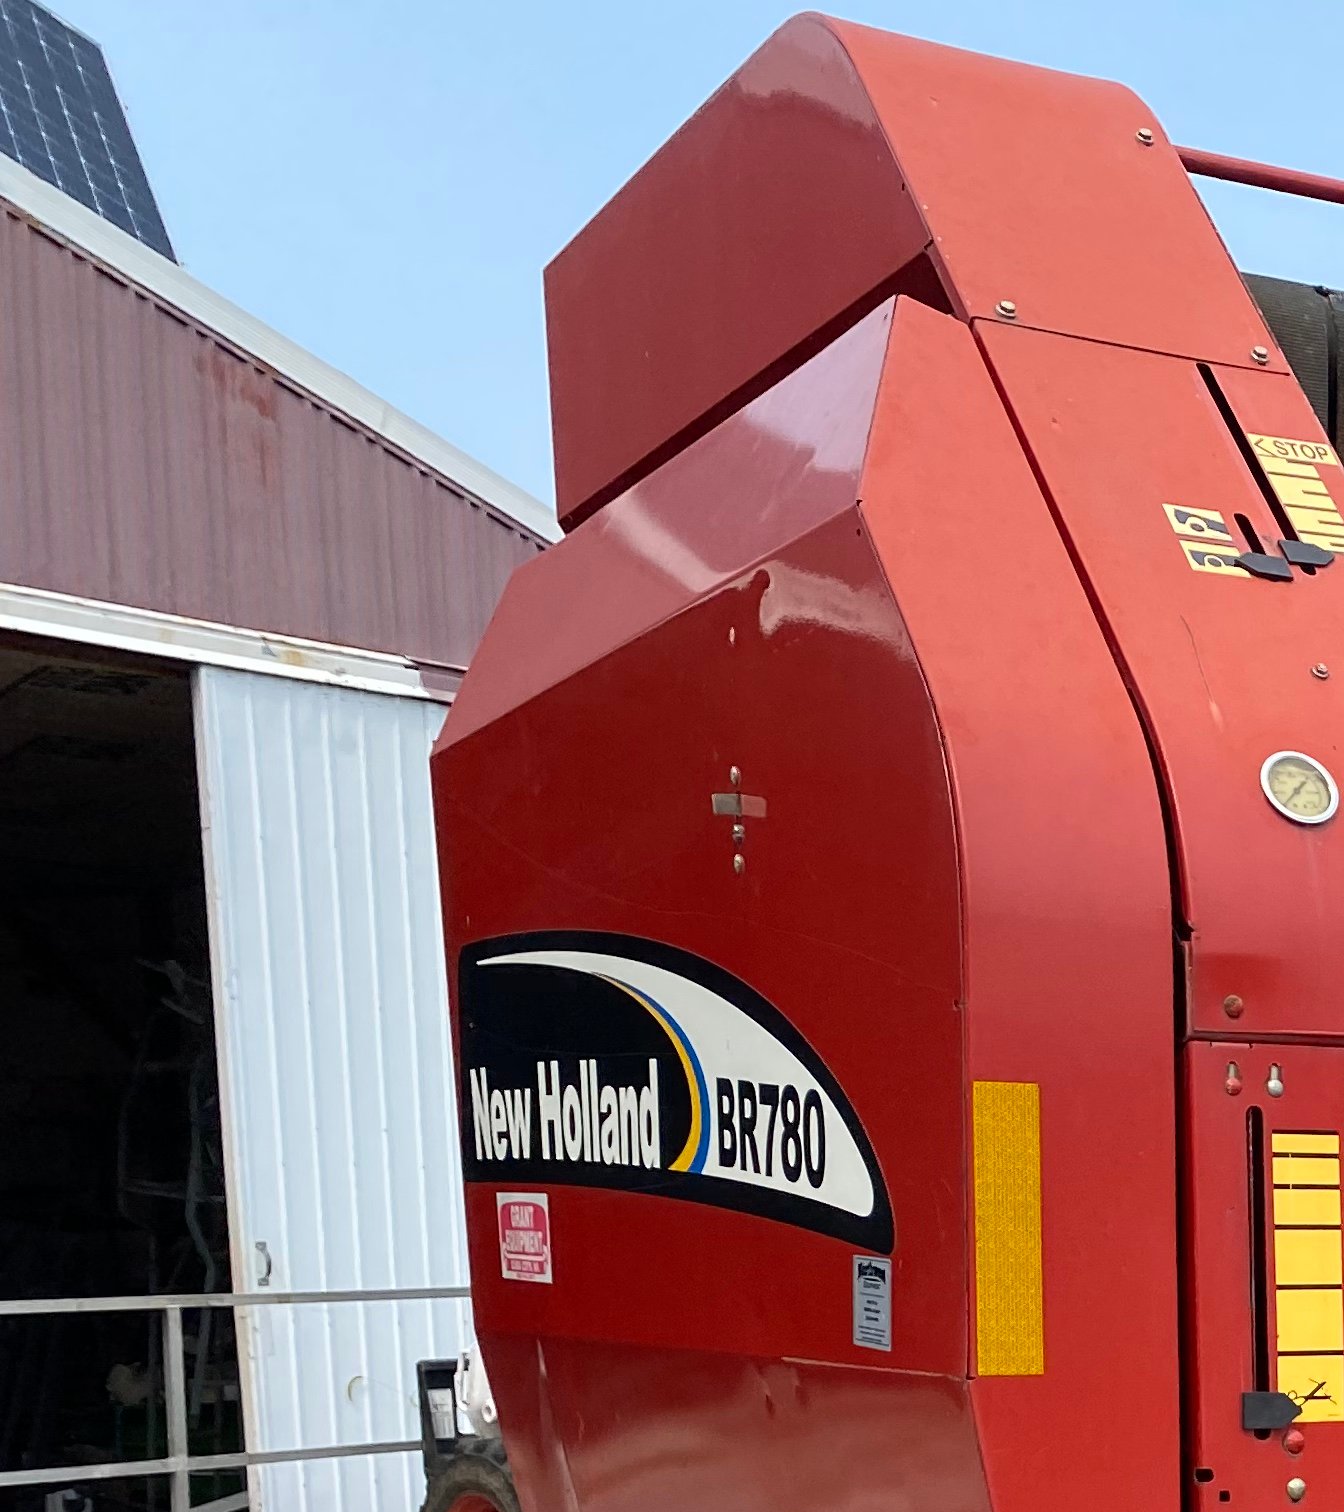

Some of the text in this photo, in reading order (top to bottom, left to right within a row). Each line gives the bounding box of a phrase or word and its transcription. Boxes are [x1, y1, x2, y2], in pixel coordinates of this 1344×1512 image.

[1273, 440, 1328, 460] STOP
[470, 1058, 661, 1169] New Holland
[716, 1077, 827, 1190] BR780
